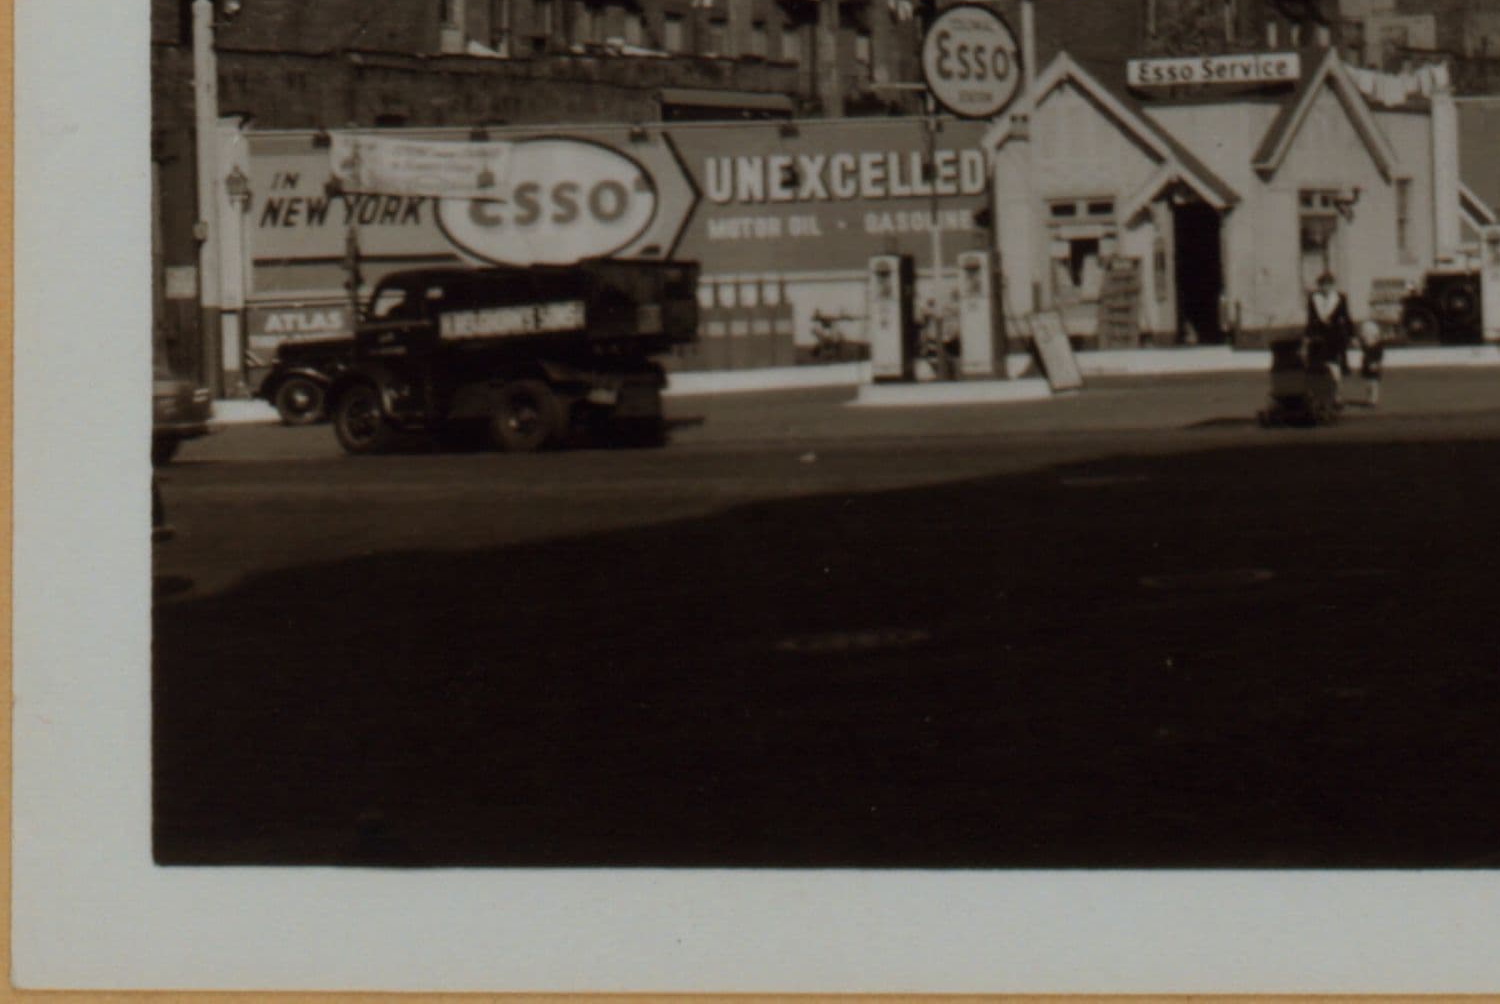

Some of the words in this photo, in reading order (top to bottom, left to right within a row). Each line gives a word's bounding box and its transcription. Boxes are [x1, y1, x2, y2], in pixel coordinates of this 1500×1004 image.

[1138, 61, 1194, 83] Esso
[1201, 58, 1288, 79] Service
[270, 172, 300, 190] IN
[704, 149, 987, 203] UNEXCELLED
[259, 196, 331, 228] NEW
[343, 193, 427, 226] YORK
[707, 215, 783, 240] MOTOR
[788, 214, 823, 238] OIL
[863, 209, 974, 234] GASOLINE
[263, 310, 344, 333] ATLAS
